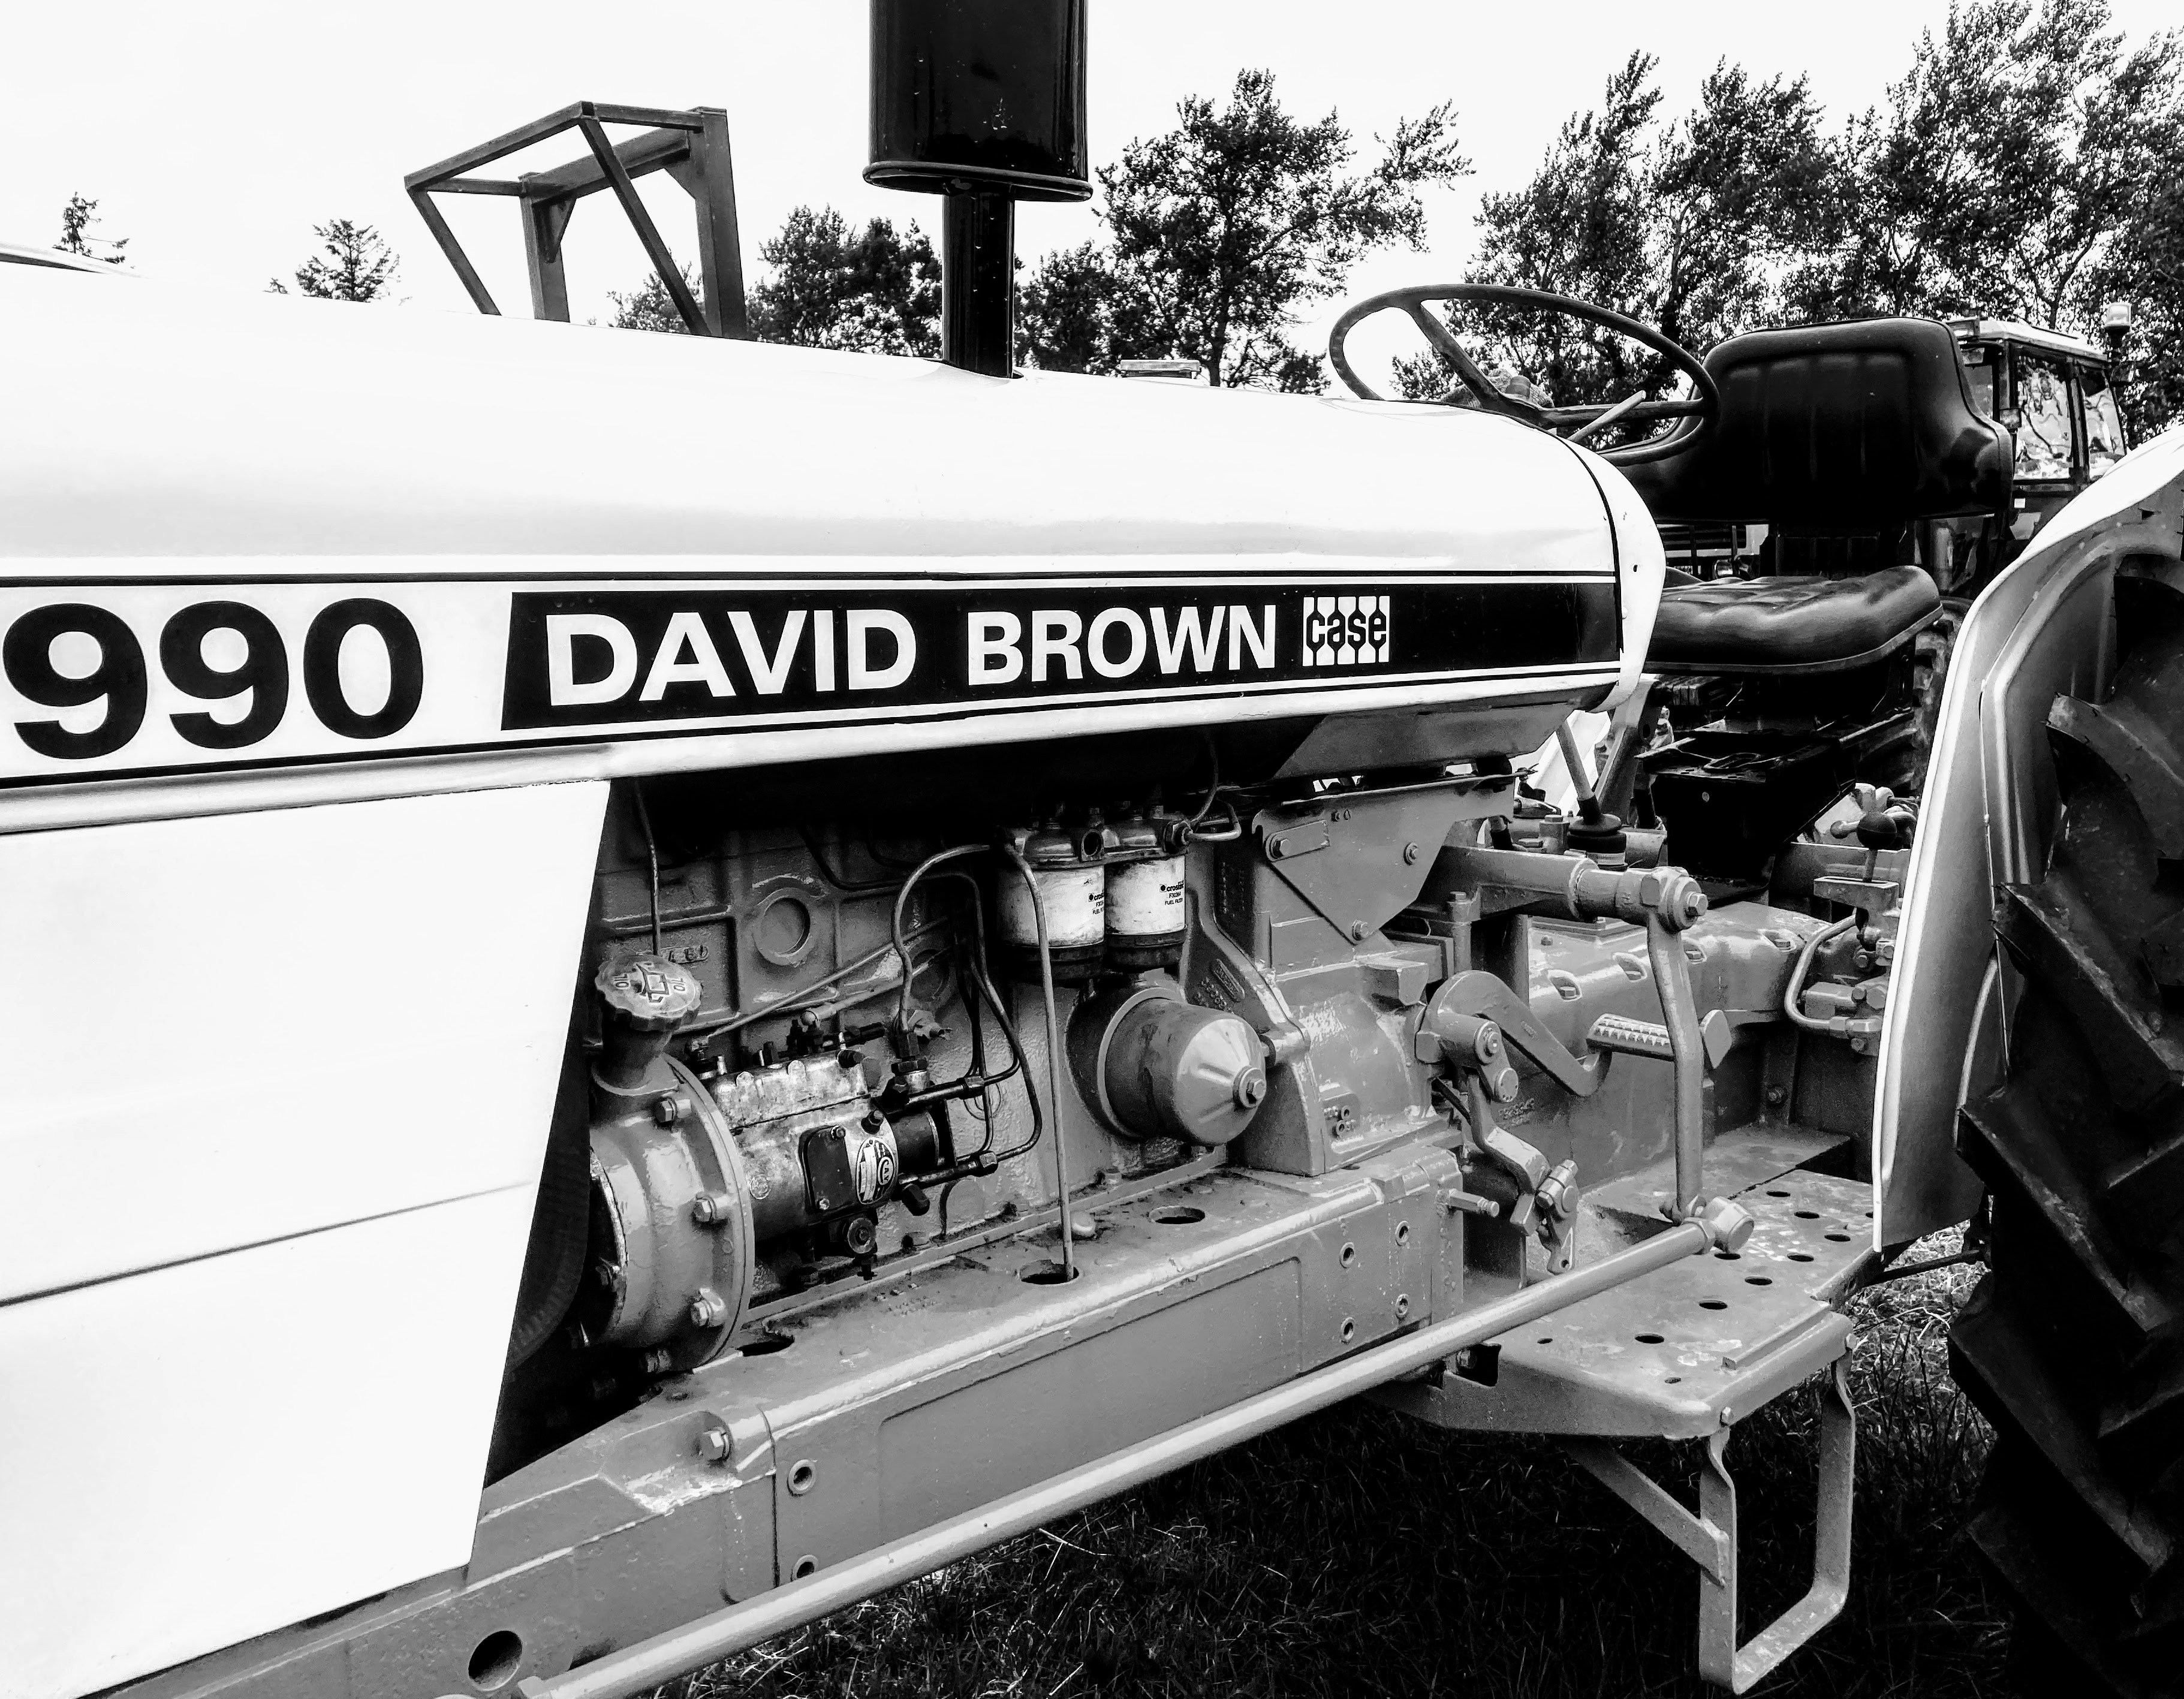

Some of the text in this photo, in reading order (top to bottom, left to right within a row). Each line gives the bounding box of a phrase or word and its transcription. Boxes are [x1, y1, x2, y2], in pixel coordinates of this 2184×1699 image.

[2, 598, 423, 760] 990
[546, 605, 1276, 706] DAVID BROWN
[613, 973, 629, 989] OIL
[671, 977, 686, 992] OIL
